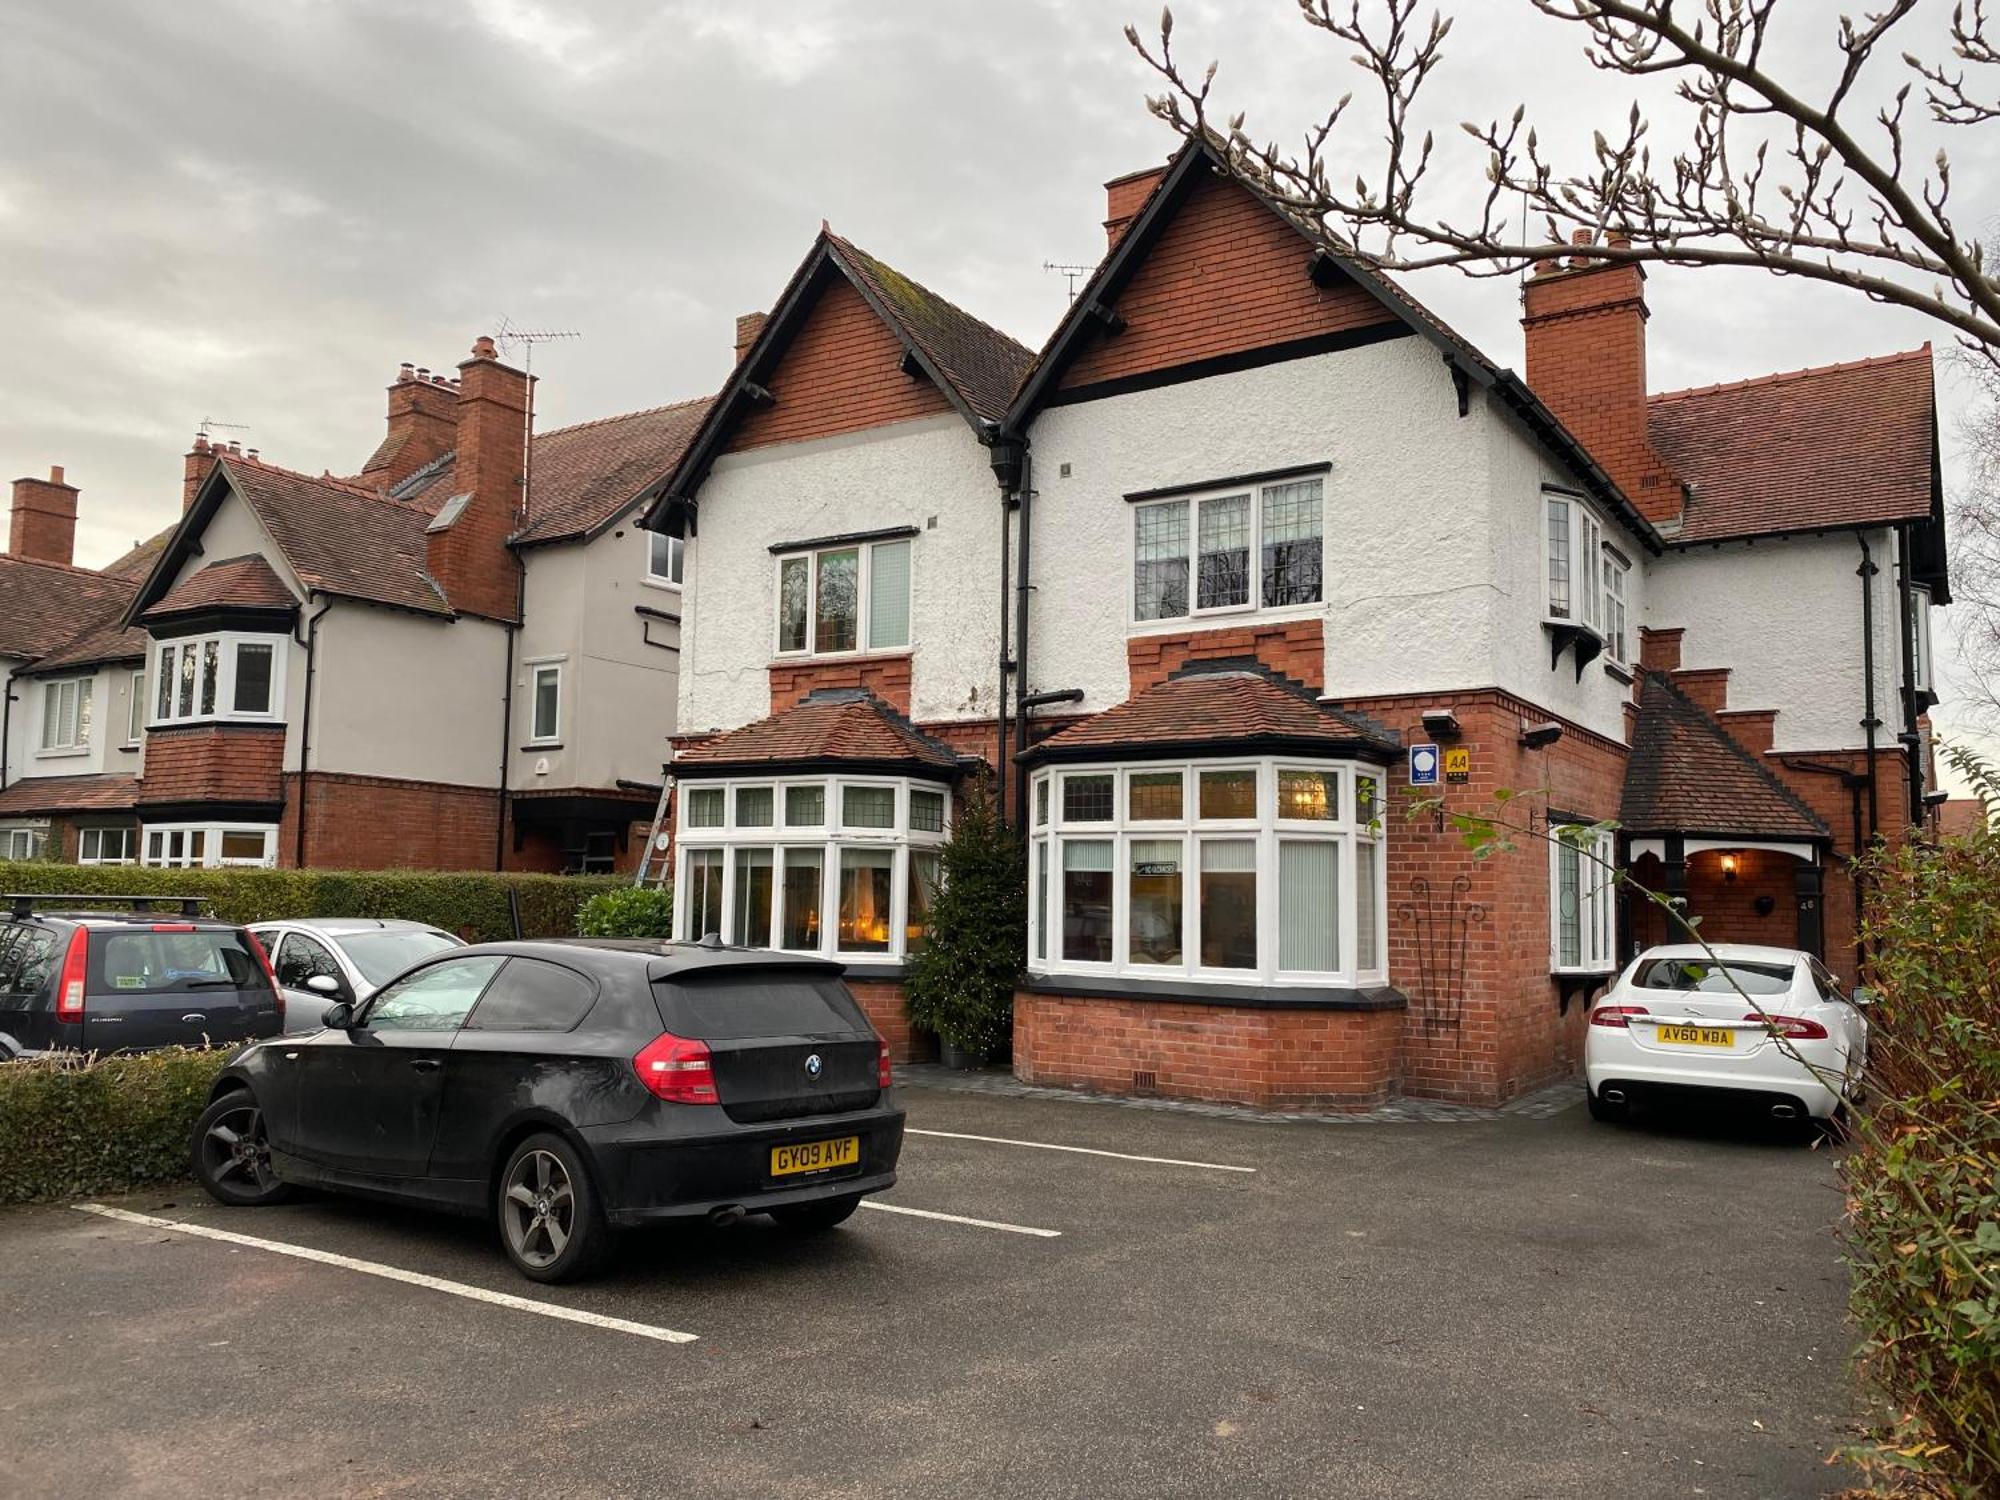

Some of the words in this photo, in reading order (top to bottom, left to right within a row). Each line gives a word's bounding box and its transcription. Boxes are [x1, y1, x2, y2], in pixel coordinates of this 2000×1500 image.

[1450, 755, 1466, 768] AA
[778, 1144, 820, 1170] GY09
[824, 1139, 852, 1163] AYF
